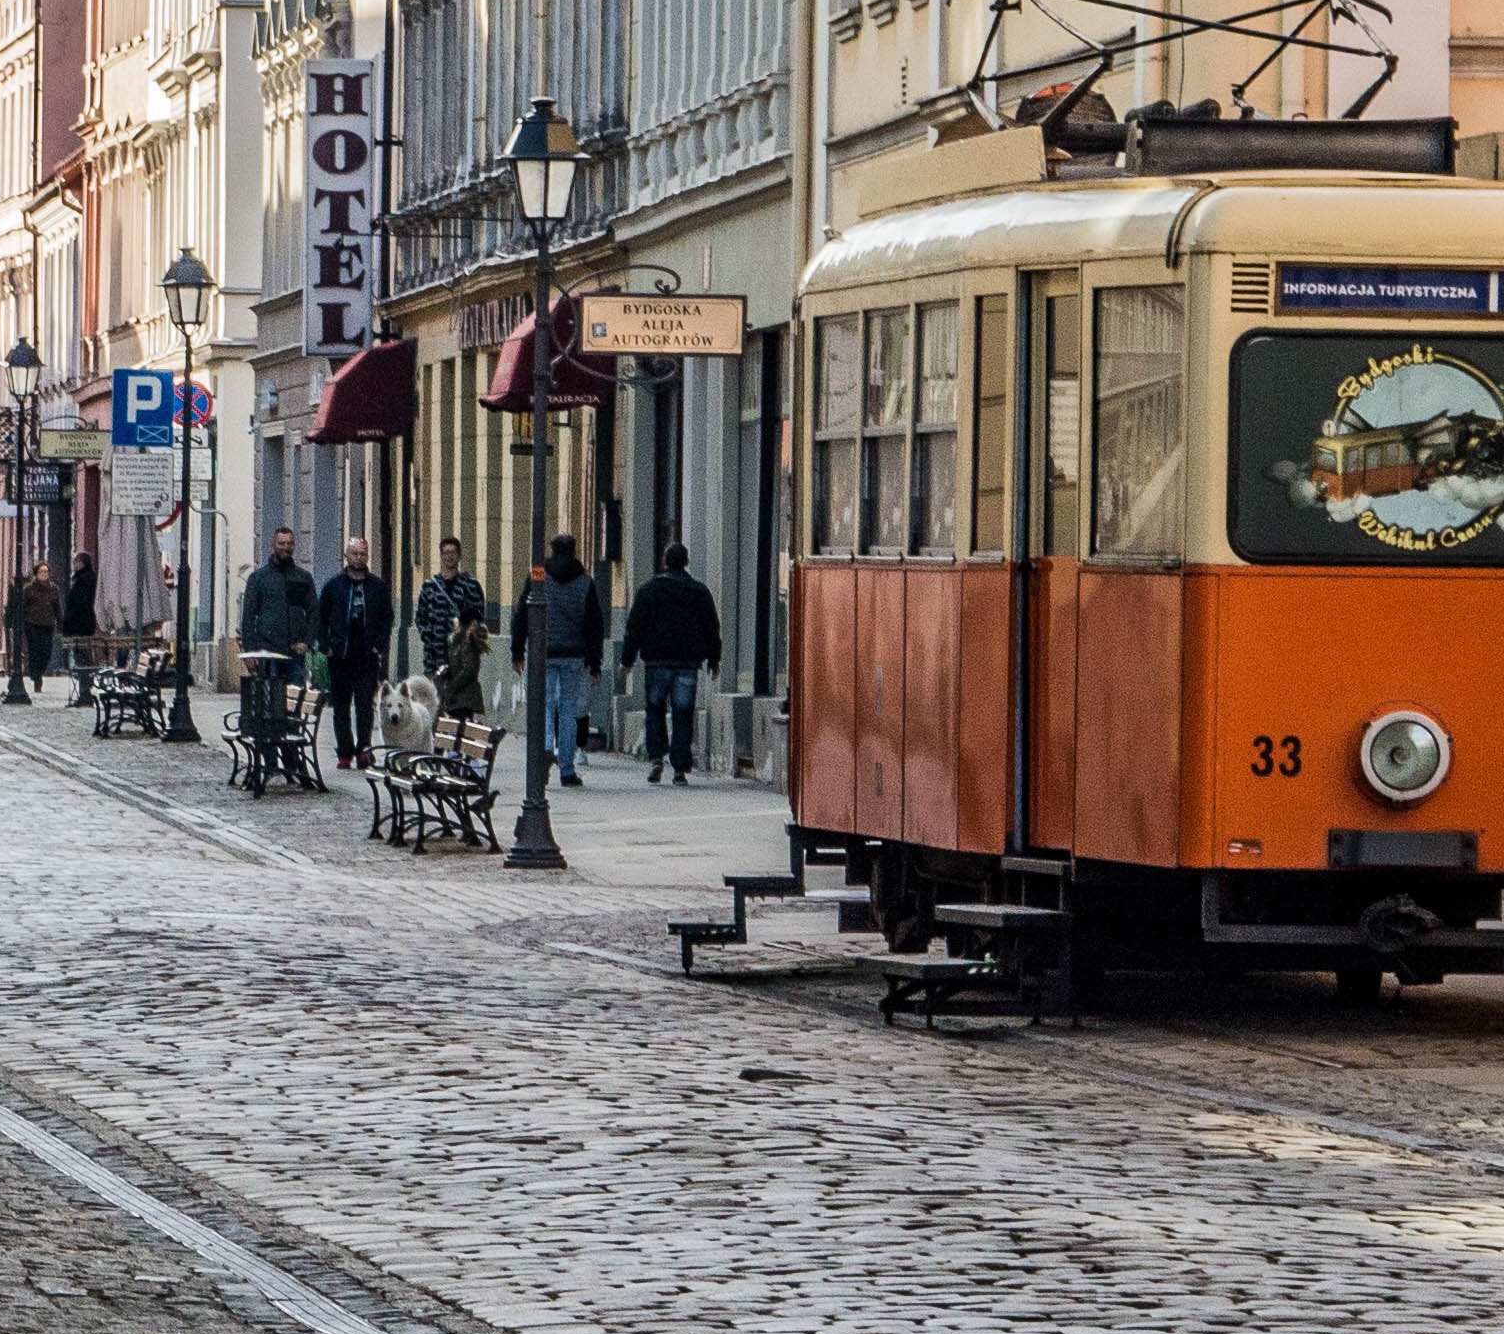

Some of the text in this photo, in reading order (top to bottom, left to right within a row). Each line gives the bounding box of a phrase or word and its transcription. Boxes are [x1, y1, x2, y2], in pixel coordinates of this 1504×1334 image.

[309, 72, 369, 348] HOTEL
[1283, 283, 1478, 299] INFORMACJA TURYSTYCZNA
[623, 303, 703, 317] BYDGOSKA
[611, 331, 715, 347] AUTOGRAFÓW
[642, 320, 685, 331] ALEJA
[1337, 344, 1434, 398] Bydgoski
[126, 375, 163, 424] P
[1250, 734, 1303, 778] 33
